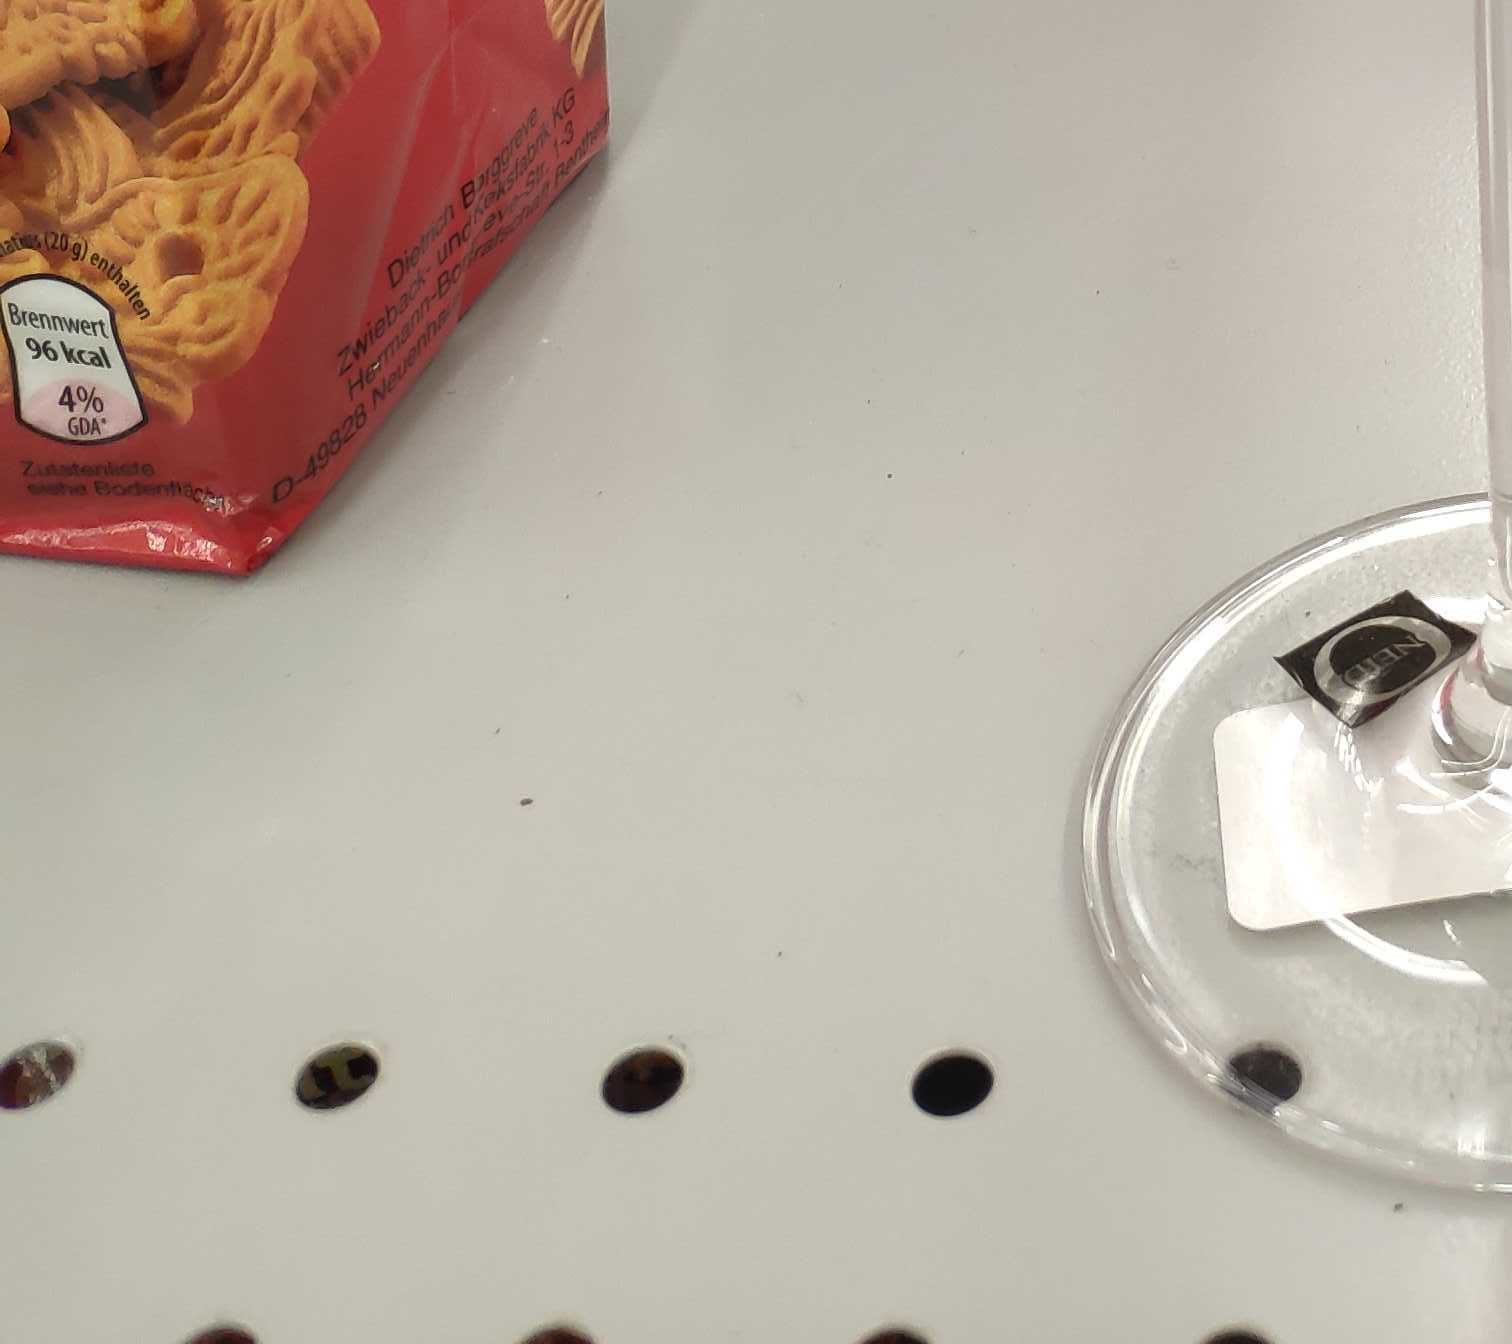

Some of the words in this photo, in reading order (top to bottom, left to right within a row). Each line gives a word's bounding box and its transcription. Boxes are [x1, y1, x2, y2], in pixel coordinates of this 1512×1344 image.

[71, 235, 88, 262] g)
[90, 251, 152, 321] enthalten
[7, 302, 110, 340] Brennwert
[25, 337, 59, 362] 96
[60, 340, 112, 369] kcal
[58, 385, 104, 413] 4%
[271, 402, 369, 505] D-49828
